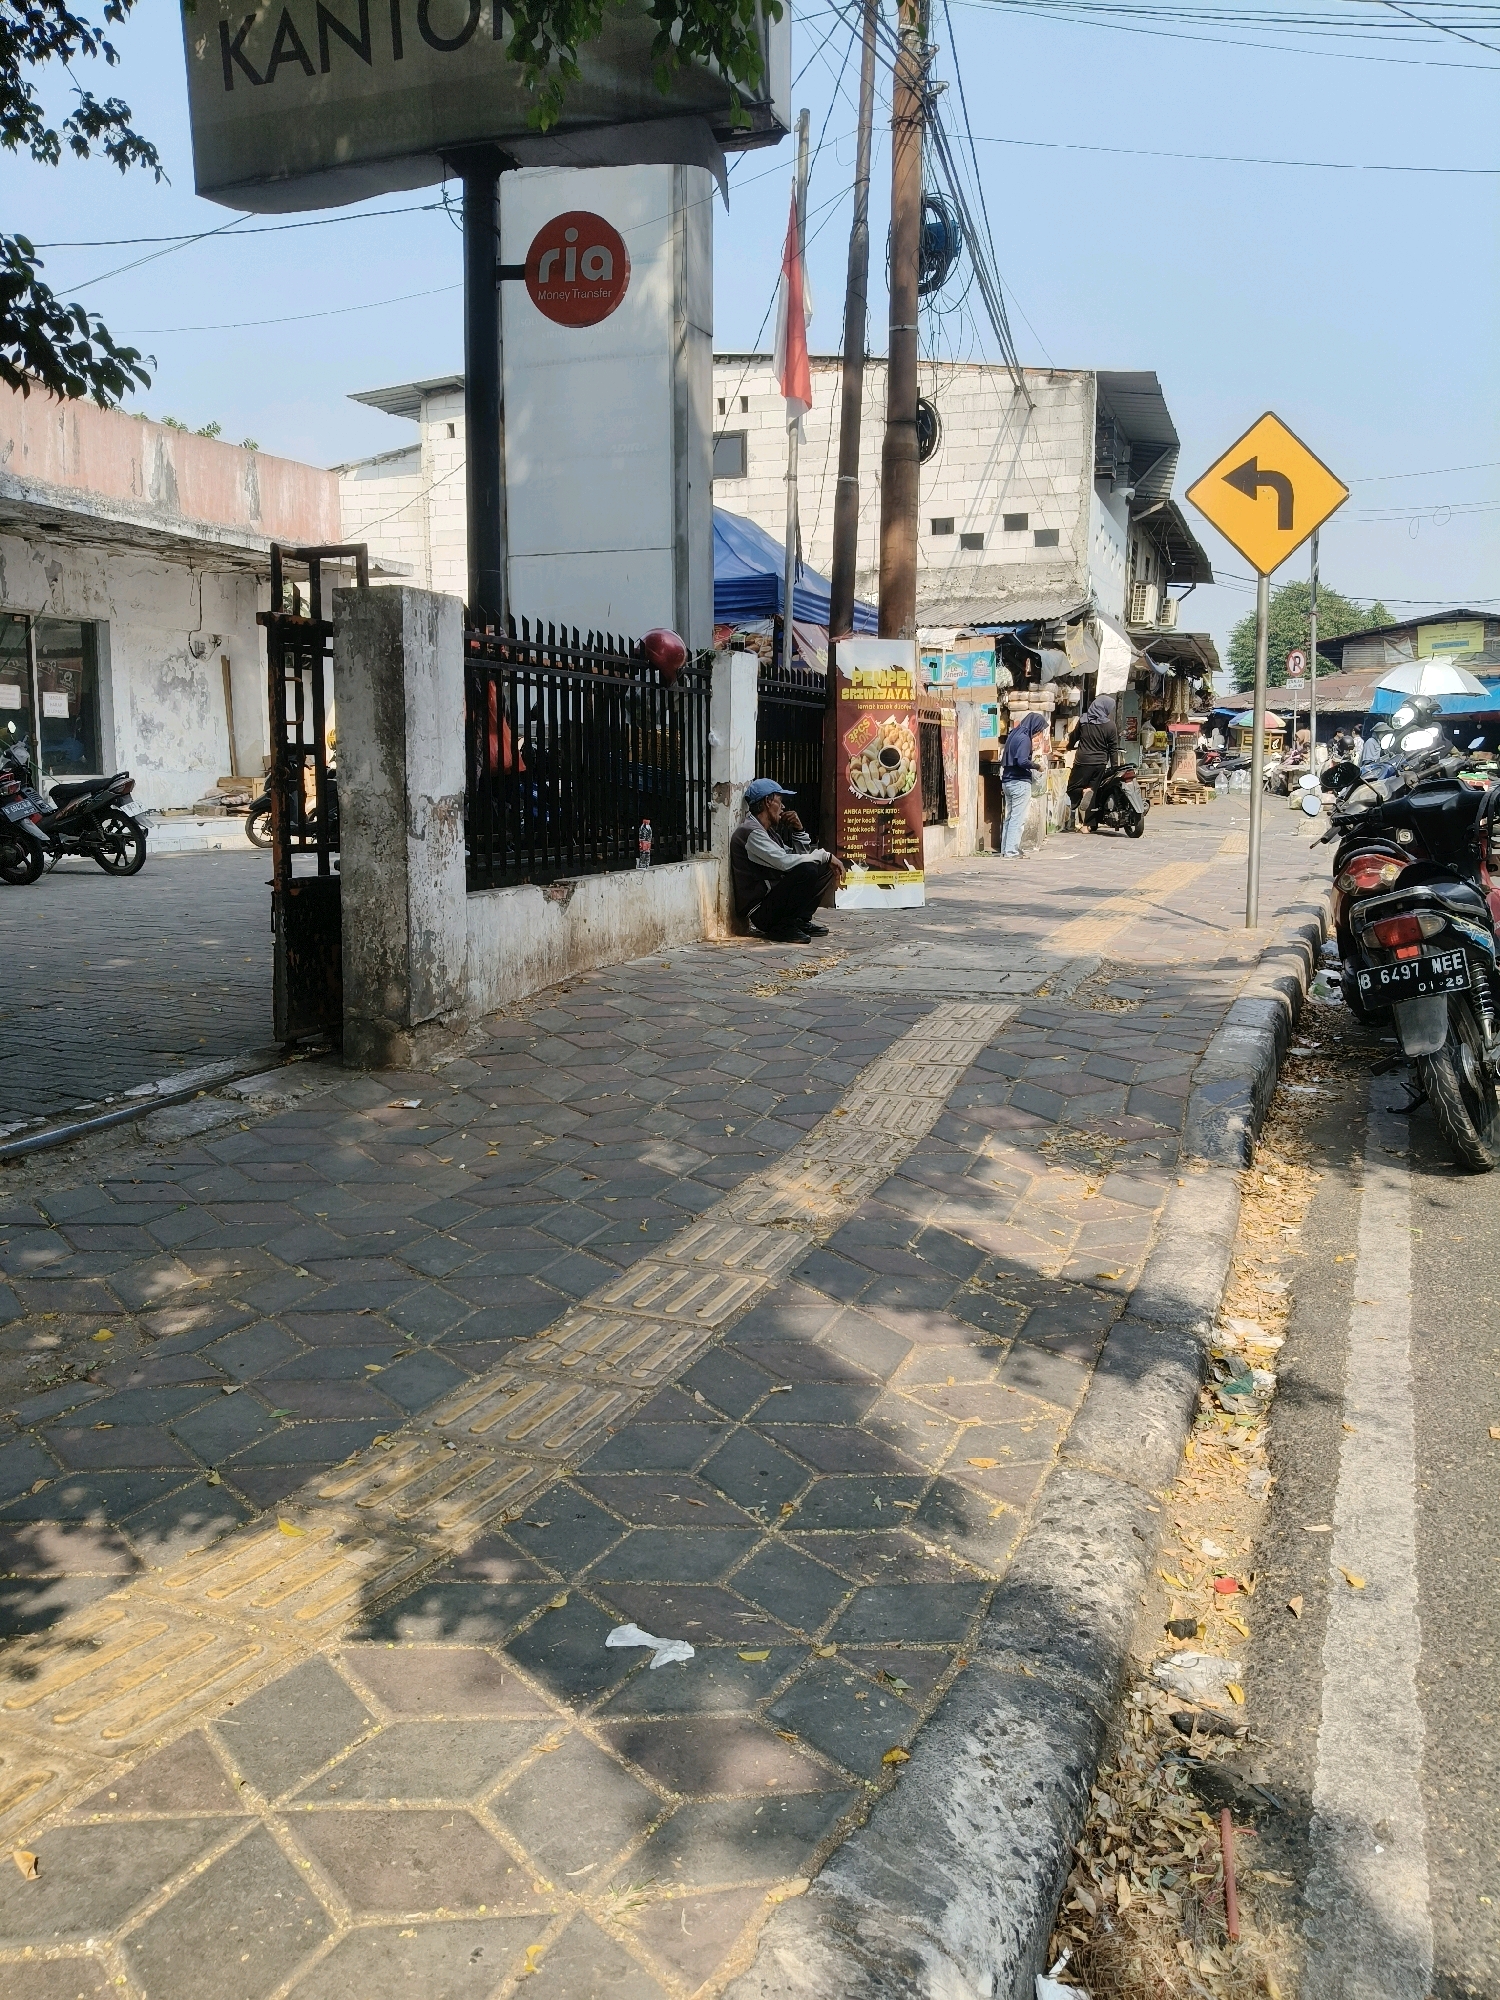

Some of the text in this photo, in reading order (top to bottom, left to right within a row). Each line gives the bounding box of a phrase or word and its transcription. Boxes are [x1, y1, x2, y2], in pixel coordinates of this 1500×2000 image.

[538, 227, 614, 284] ria
[538, 287, 612, 302] Money Transfer
[842, 688, 909, 700] SRIWIJAYA
[848, 718, 871, 743] 3PCS
[854, 728, 873, 749] 10K
[1360, 973, 1371, 990] B
[1380, 962, 1419, 984] 6497
